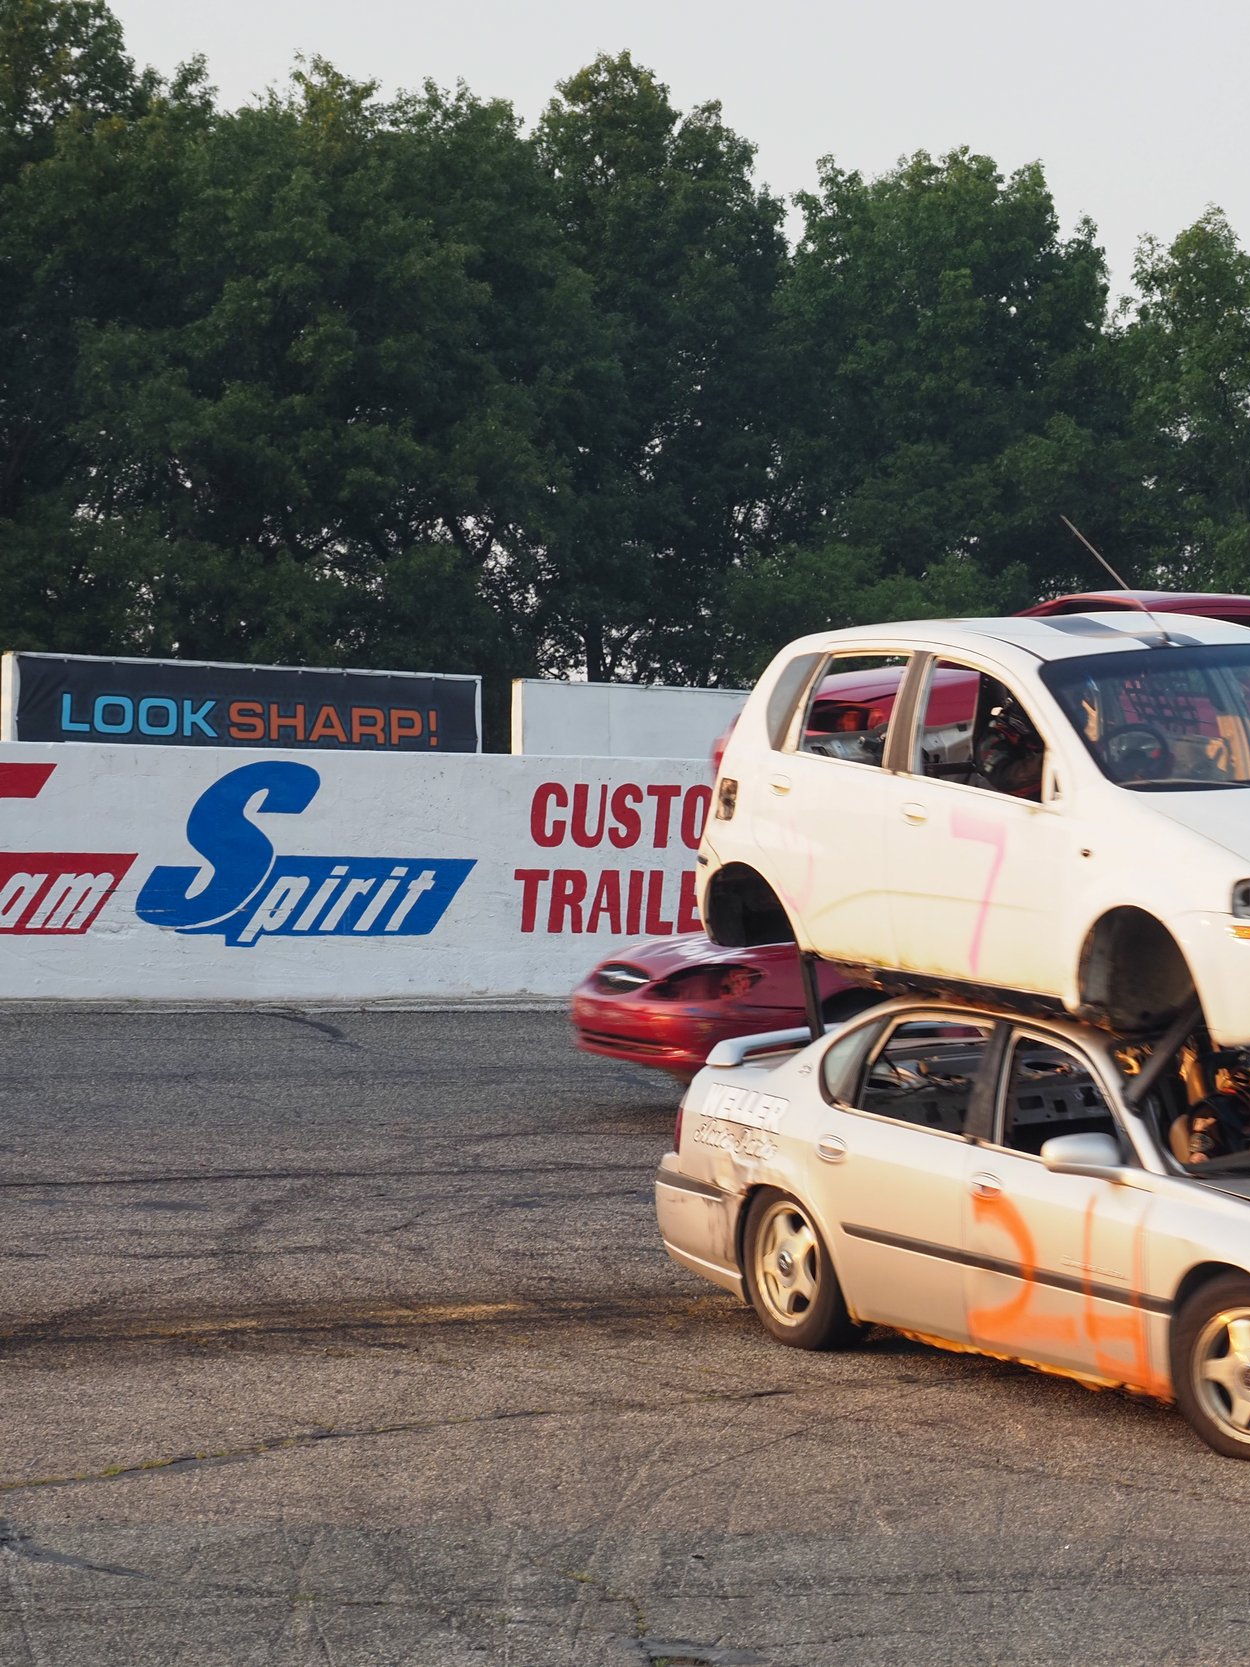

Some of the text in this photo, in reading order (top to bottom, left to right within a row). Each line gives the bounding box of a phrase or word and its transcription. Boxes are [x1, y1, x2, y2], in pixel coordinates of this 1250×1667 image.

[61, 693, 439, 746] LOOK SHARP!
[135, 761, 440, 946] Spirit
[700, 1082, 792, 1136] WELLER
